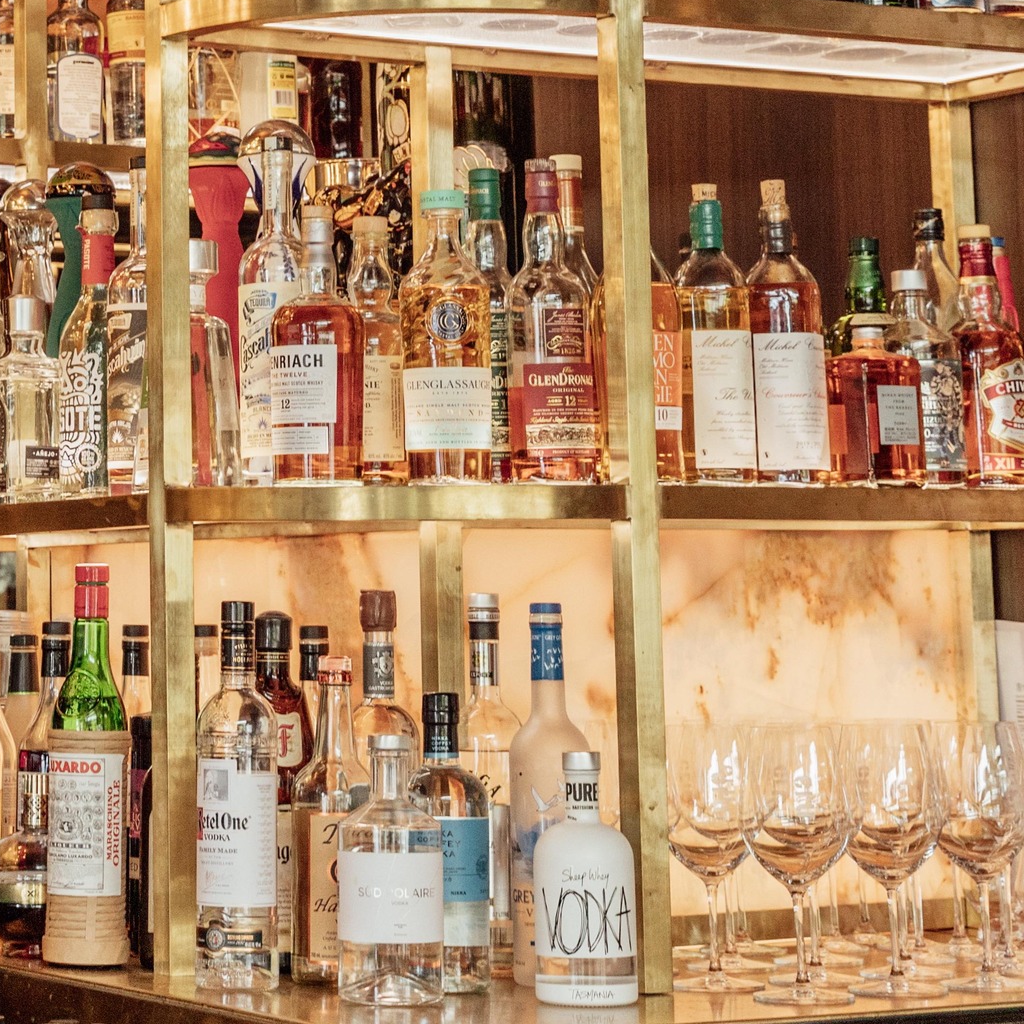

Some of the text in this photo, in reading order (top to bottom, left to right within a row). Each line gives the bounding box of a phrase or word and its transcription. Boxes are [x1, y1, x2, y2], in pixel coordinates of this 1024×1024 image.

[249, 297, 271, 308] TEQUILA
[758, 338, 802, 351] Michel
[714, 387, 739, 401] The
[994, 379, 1024, 395] CHI
[280, 398, 291, 410] 12
[564, 395, 577, 407] 12
[657, 408, 668, 422] 10
[35, 449, 56, 457] AÑEJO
[993, 456, 1016, 470] XII
[565, 782, 598, 803] PURE
[113, 779, 121, 867] ORIGINALE
[221, 812, 249, 831] One
[203, 833, 231, 842] VODKA
[217, 847, 238, 855] MADE
[561, 869, 610, 885] Sheep Whey
[541, 885, 632, 956] VODKA
[567, 988, 615, 1001] TASMANIA
